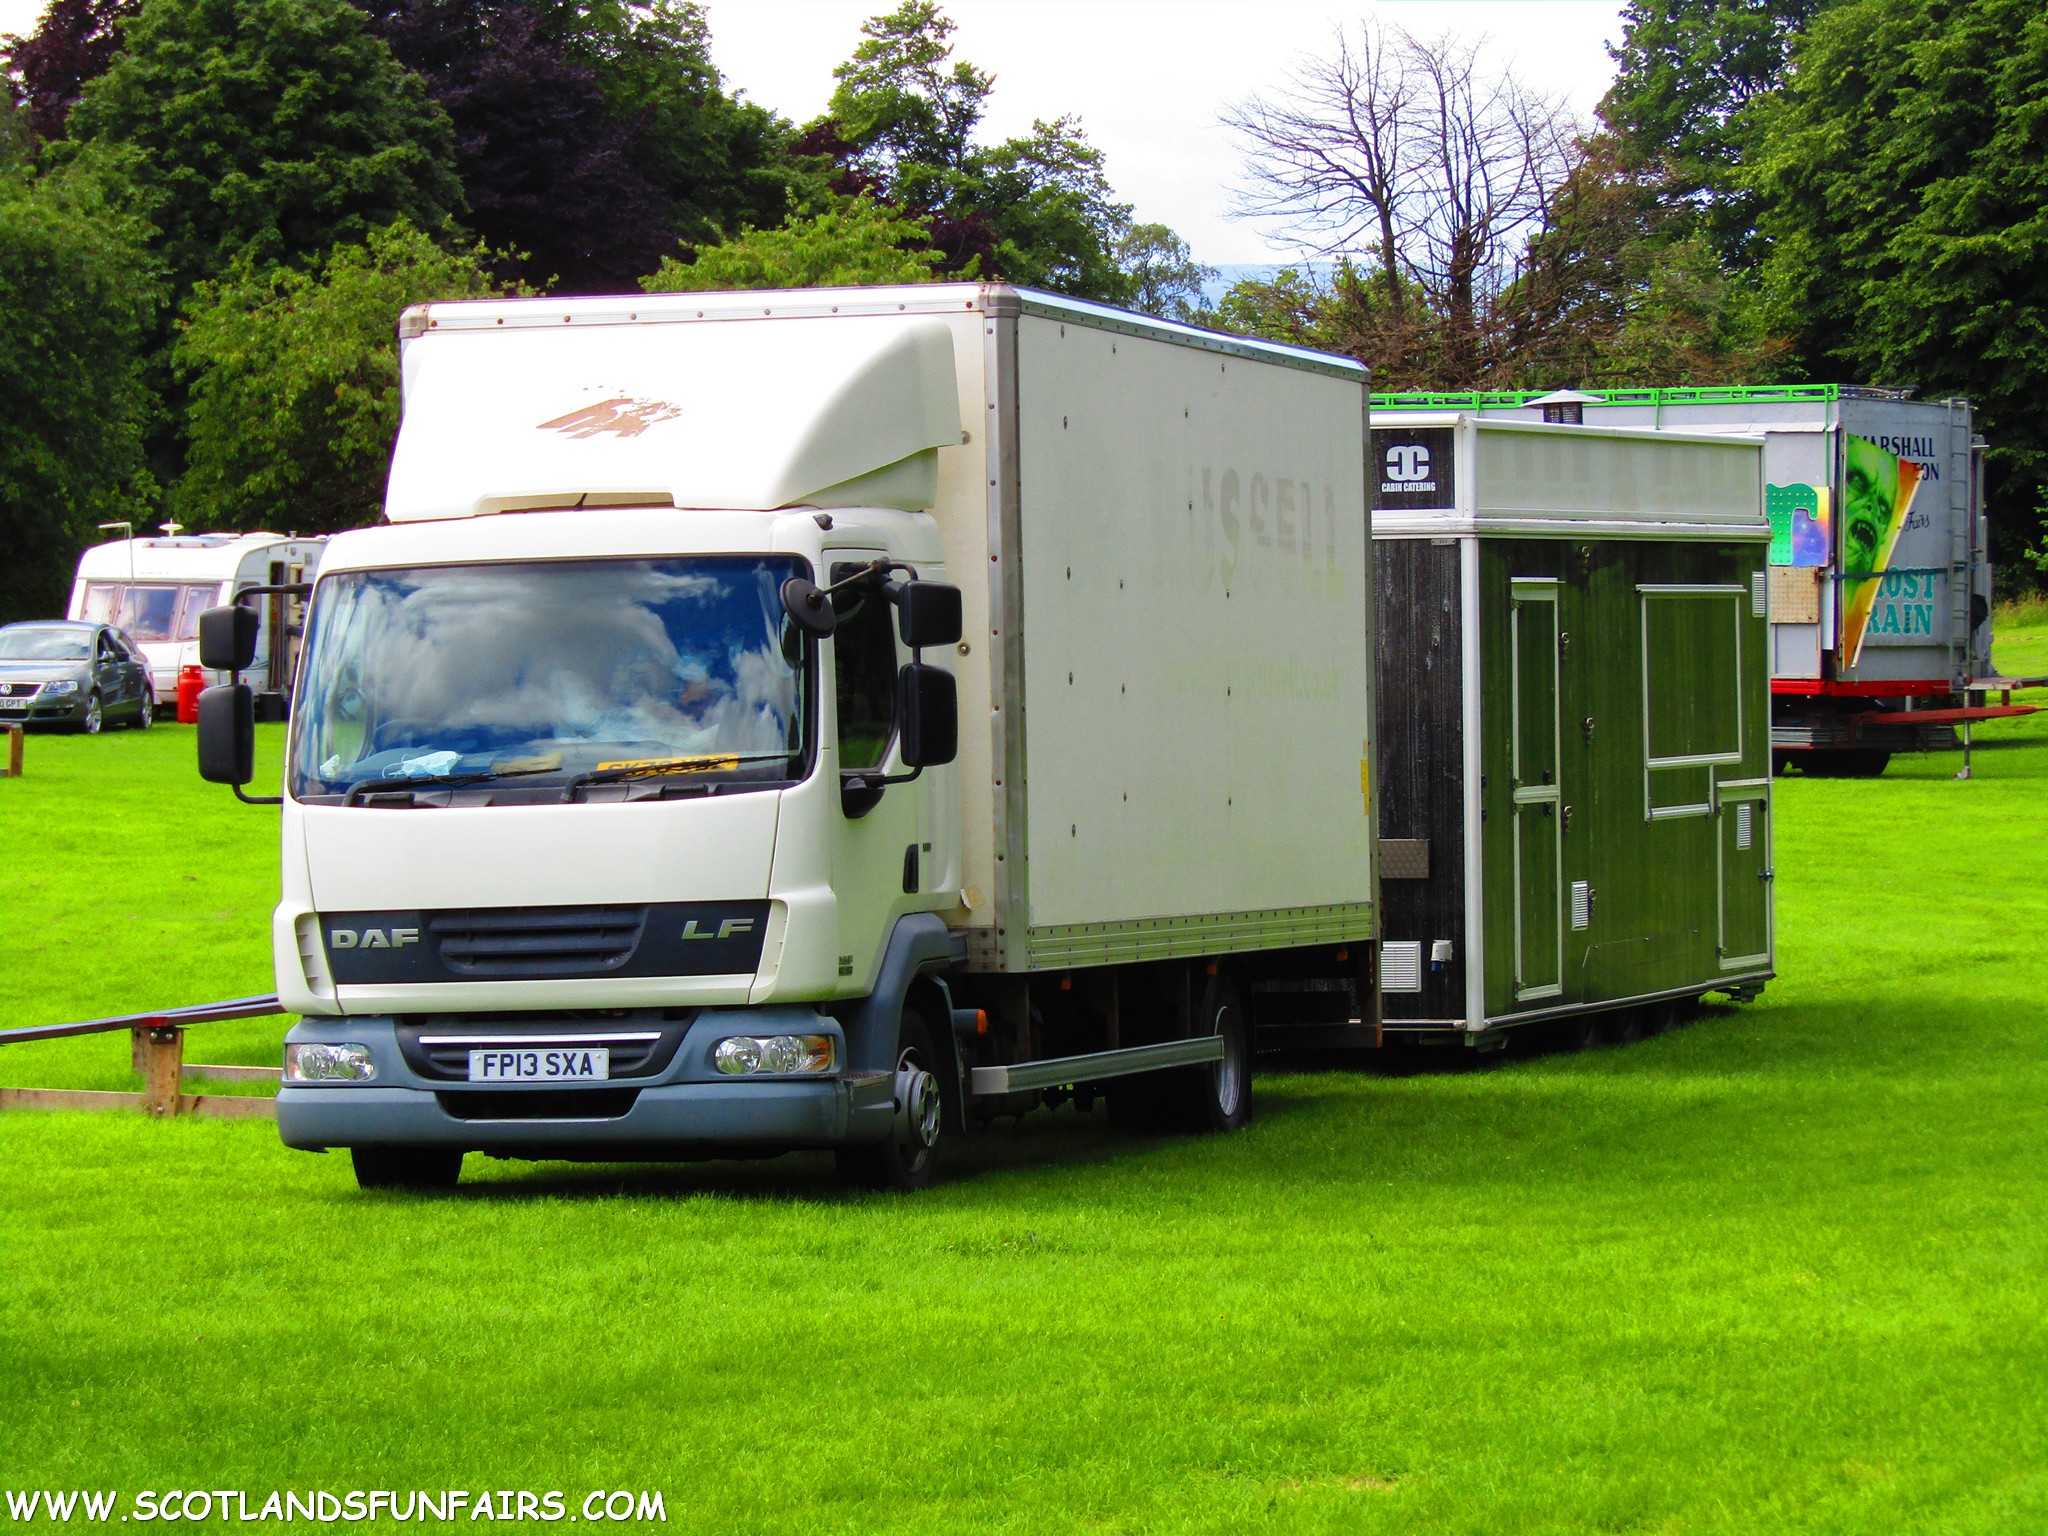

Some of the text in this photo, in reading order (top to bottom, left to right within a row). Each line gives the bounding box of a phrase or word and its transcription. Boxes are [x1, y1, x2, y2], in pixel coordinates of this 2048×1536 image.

[1381, 481, 1436, 493] CABIN CATERING
[331, 928, 419, 949] DAF
[681, 918, 755, 940] LF
[483, 1052, 593, 1077] FP13 SXA
